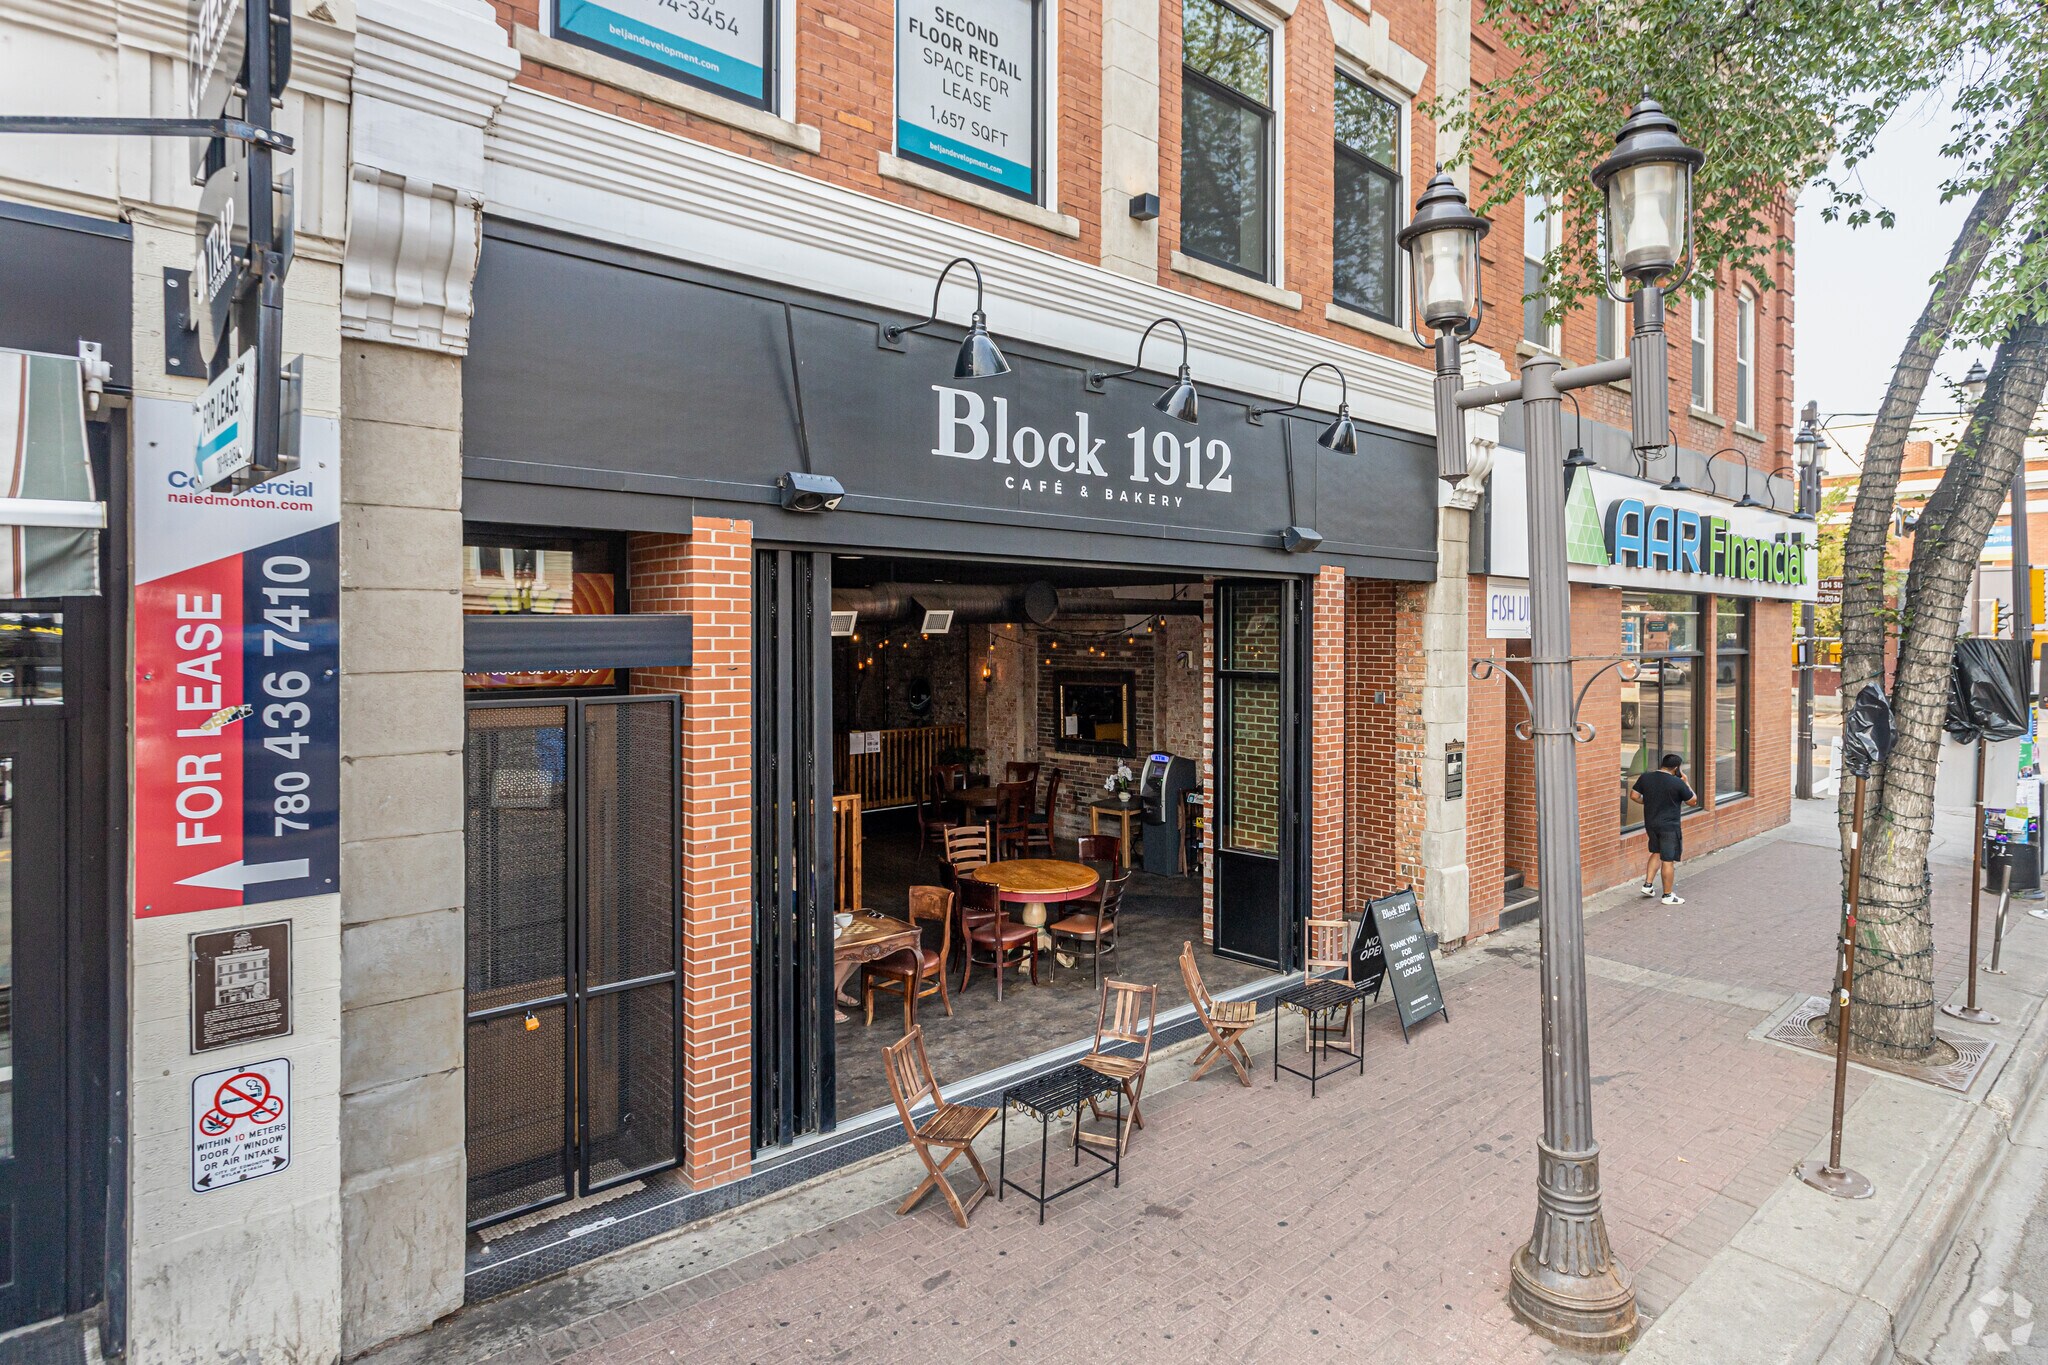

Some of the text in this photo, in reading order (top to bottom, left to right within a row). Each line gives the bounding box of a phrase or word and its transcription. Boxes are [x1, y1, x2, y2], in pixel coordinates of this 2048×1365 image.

[935, 6, 999, 47] SECOND
[609, 23, 720, 73] beljandevelopment.com
[909, 17, 1022, 81] FLOOR RETAIL
[923, 47, 1009, 97] SPACE FOR
[943, 78, 992, 113] LEASE
[930, 105, 1009, 148] 1,657 SQFT
[929, 141, 1003, 175] beljandevelopment.com
[216, 376, 239, 426] LEASE
[931, 384, 1232, 493] Block 1912
[168, 470, 313, 498] Cercial
[1005, 477, 1183, 508] CAFÉ & BAKERY
[168, 492, 313, 512] naiedmonton.com
[1613, 498, 1808, 586] AAR Financial
[1491, 594, 1515, 621] FISH
[263, 555, 311, 837] 780 436 7410
[175, 593, 223, 847] FOR LEASE
[1381, 906, 1398, 920] Block
[1397, 902, 1411, 914] 1912
[1364, 935, 1381, 949] NO
[1390, 936, 1418, 951] THANK YOU
[1401, 947, 1412, 957] FOR
[1394, 952, 1426, 971] SUPPORTING
[1402, 964, 1422, 978] LOCALS
[196, 1123, 287, 1152] WITHIN 10 METERS
[200, 1135, 283, 1162] DOOR / WINDOW
[204, 1145, 280, 1171] OR AIR INTAKE
